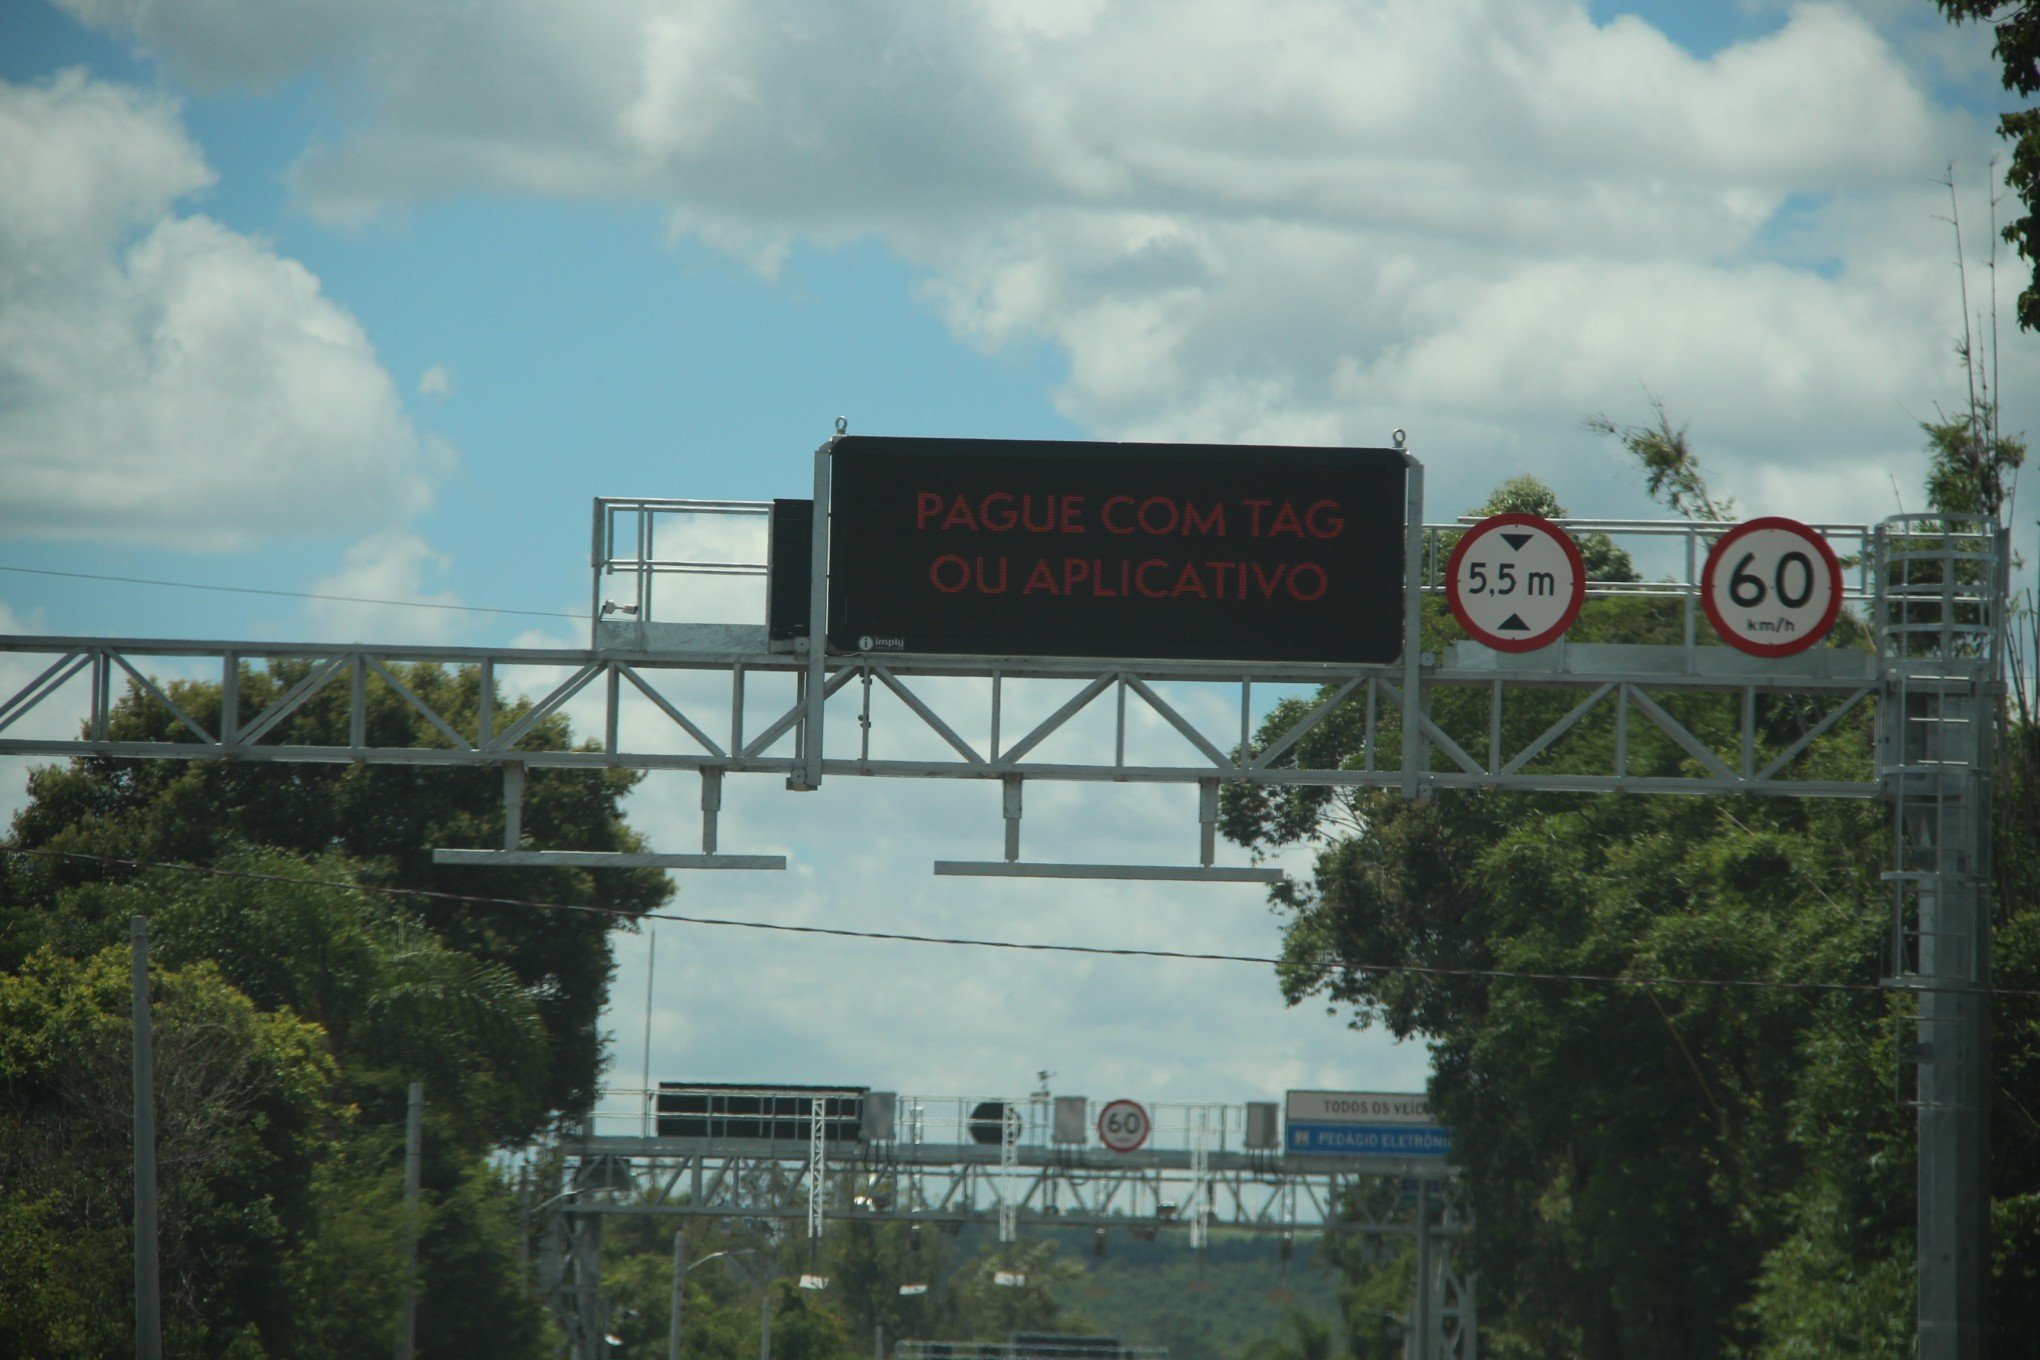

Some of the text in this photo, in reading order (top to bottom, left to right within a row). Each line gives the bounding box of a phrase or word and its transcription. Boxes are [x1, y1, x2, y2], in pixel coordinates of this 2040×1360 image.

[917, 493, 1344, 539] PAGUE COM TAG
[929, 555, 1328, 601] OU APLICATIVO
[1469, 562, 1555, 598] 5,5 m
[1730, 551, 1814, 608] 60
[1747, 617, 1795, 634] km/h
[1324, 1100, 1368, 1115] TODOS
[1373, 1101, 1387, 1115] OS
[1108, 1113, 1140, 1134] 60
[1319, 1129, 1378, 1147] PEDÁGIO
